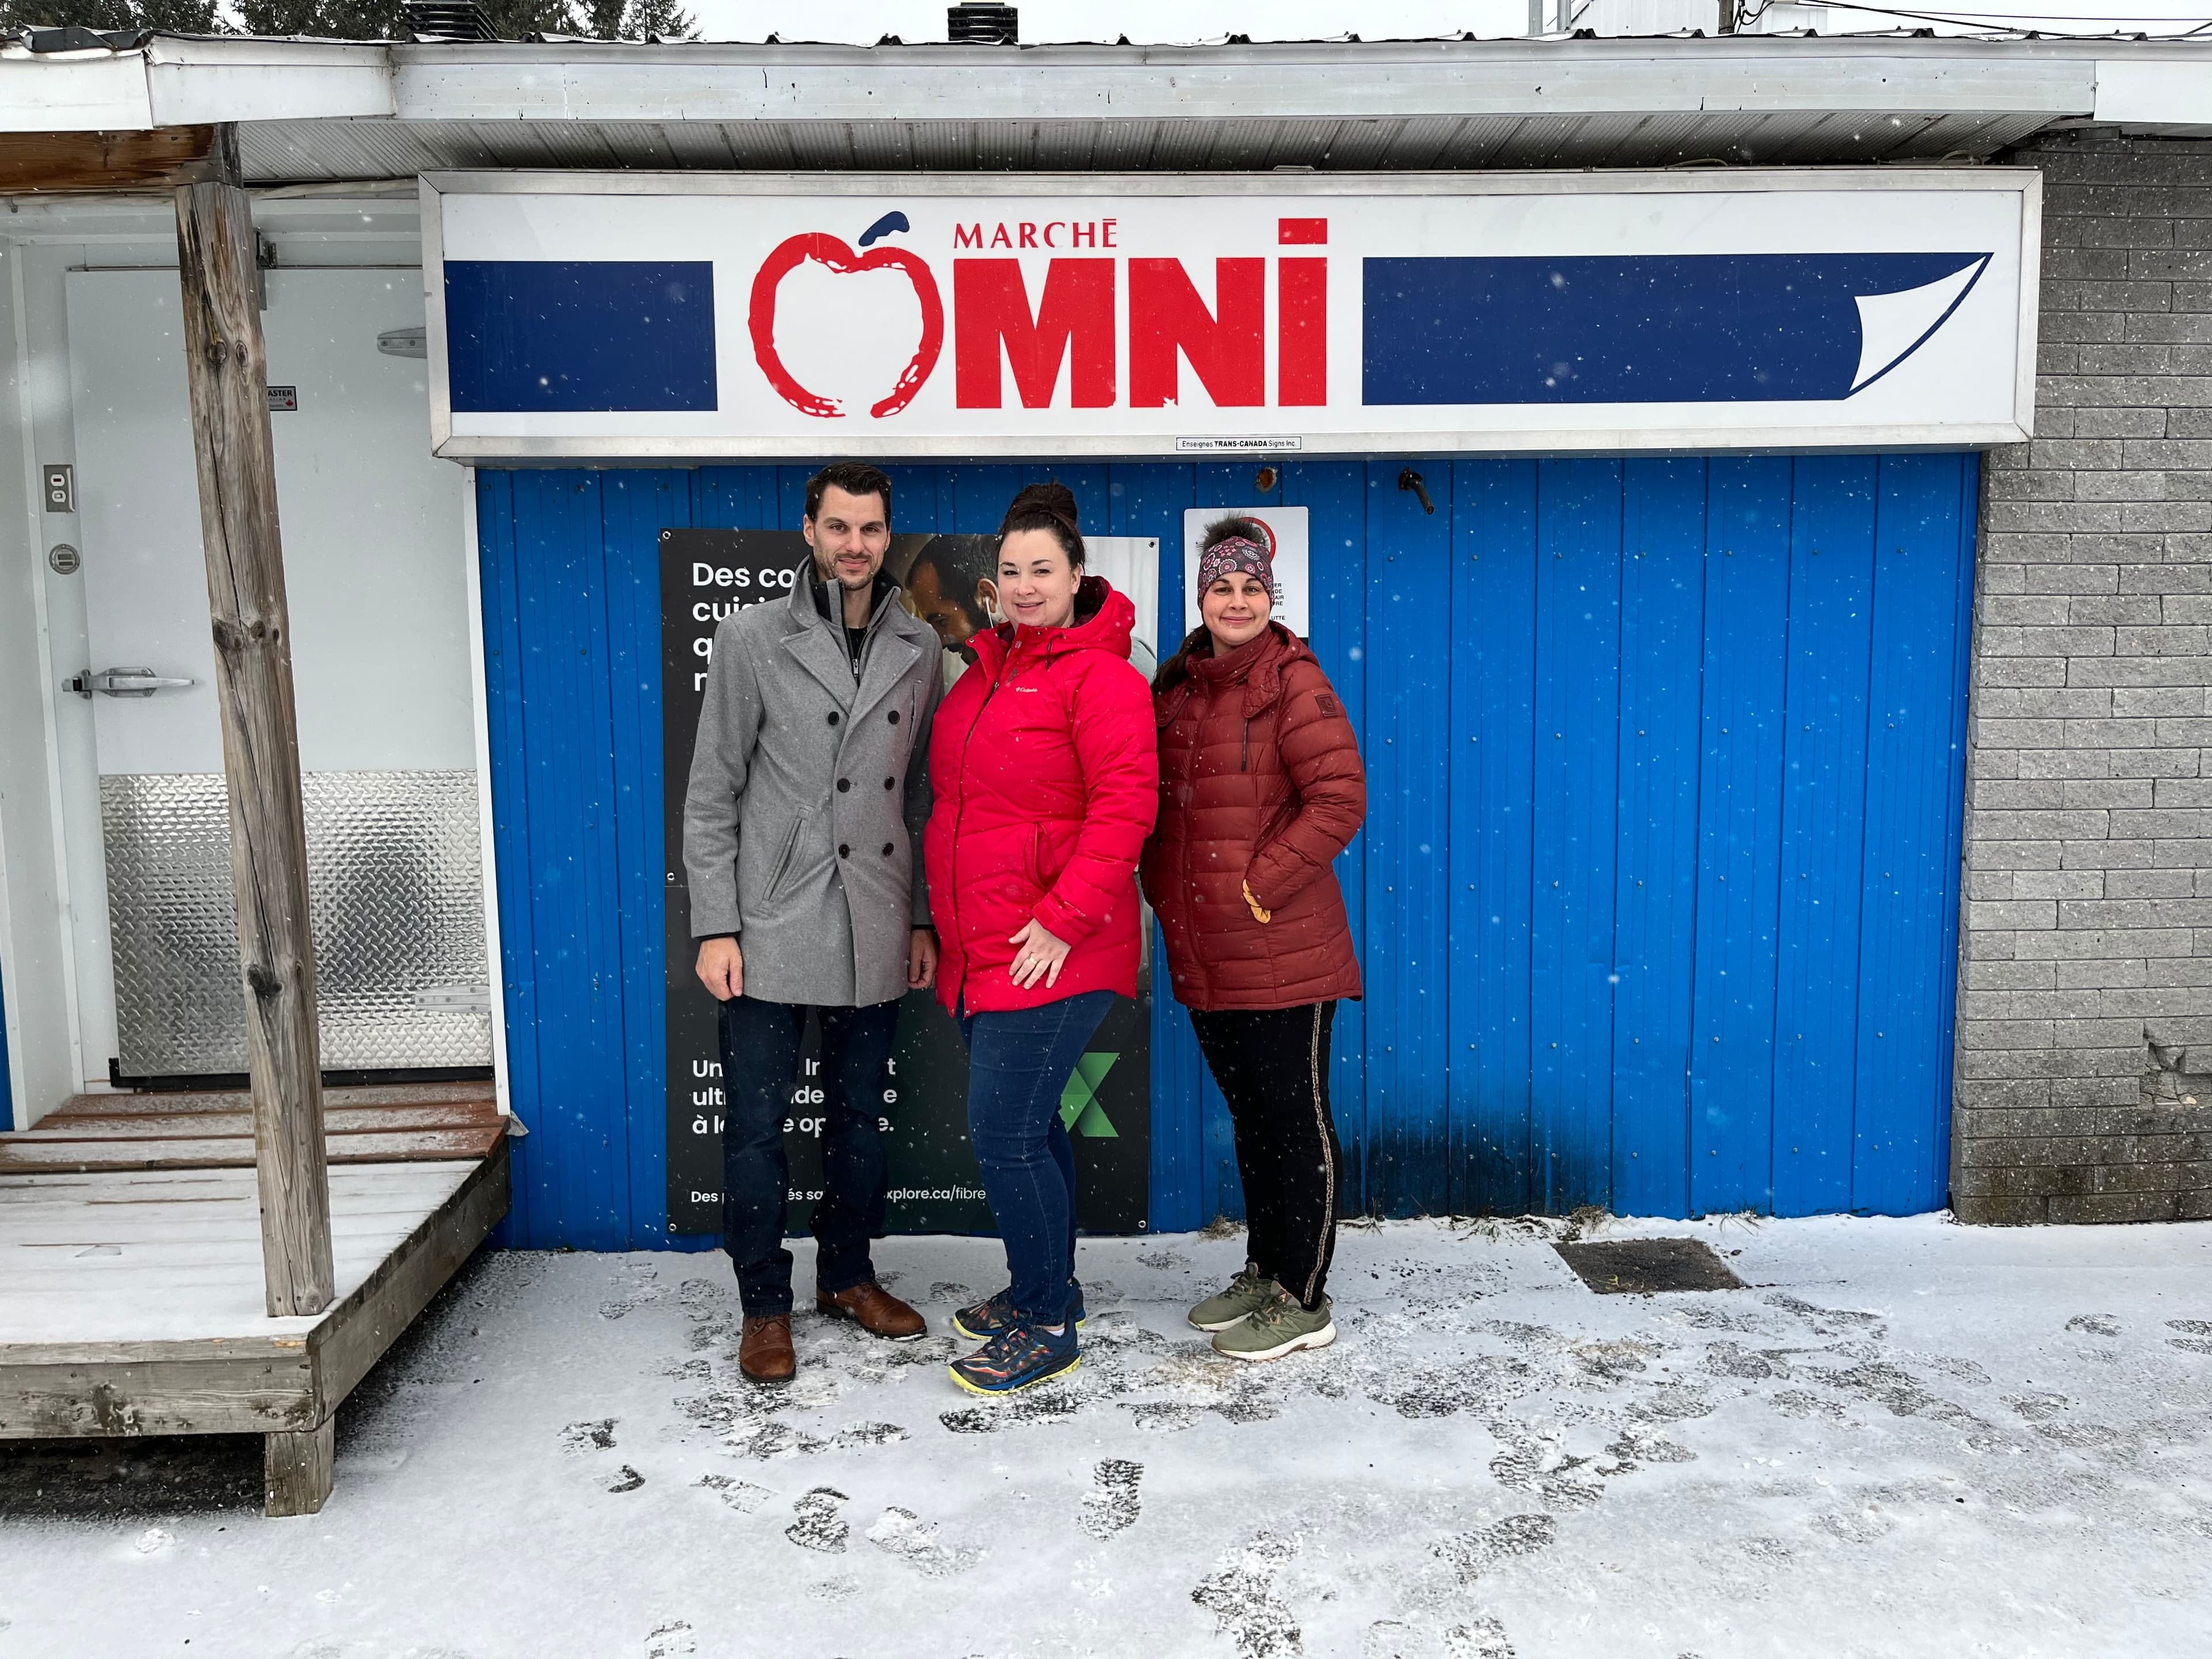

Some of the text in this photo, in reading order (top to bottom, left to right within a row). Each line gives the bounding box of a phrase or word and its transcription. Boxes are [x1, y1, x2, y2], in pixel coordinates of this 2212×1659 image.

[1182, 440, 1213, 448] Enseignes
[1268, 440, 1285, 448] Signs
[693, 562, 796, 588] Des co
[692, 1114, 707, 1134] à
[691, 1191, 718, 1203] Des
